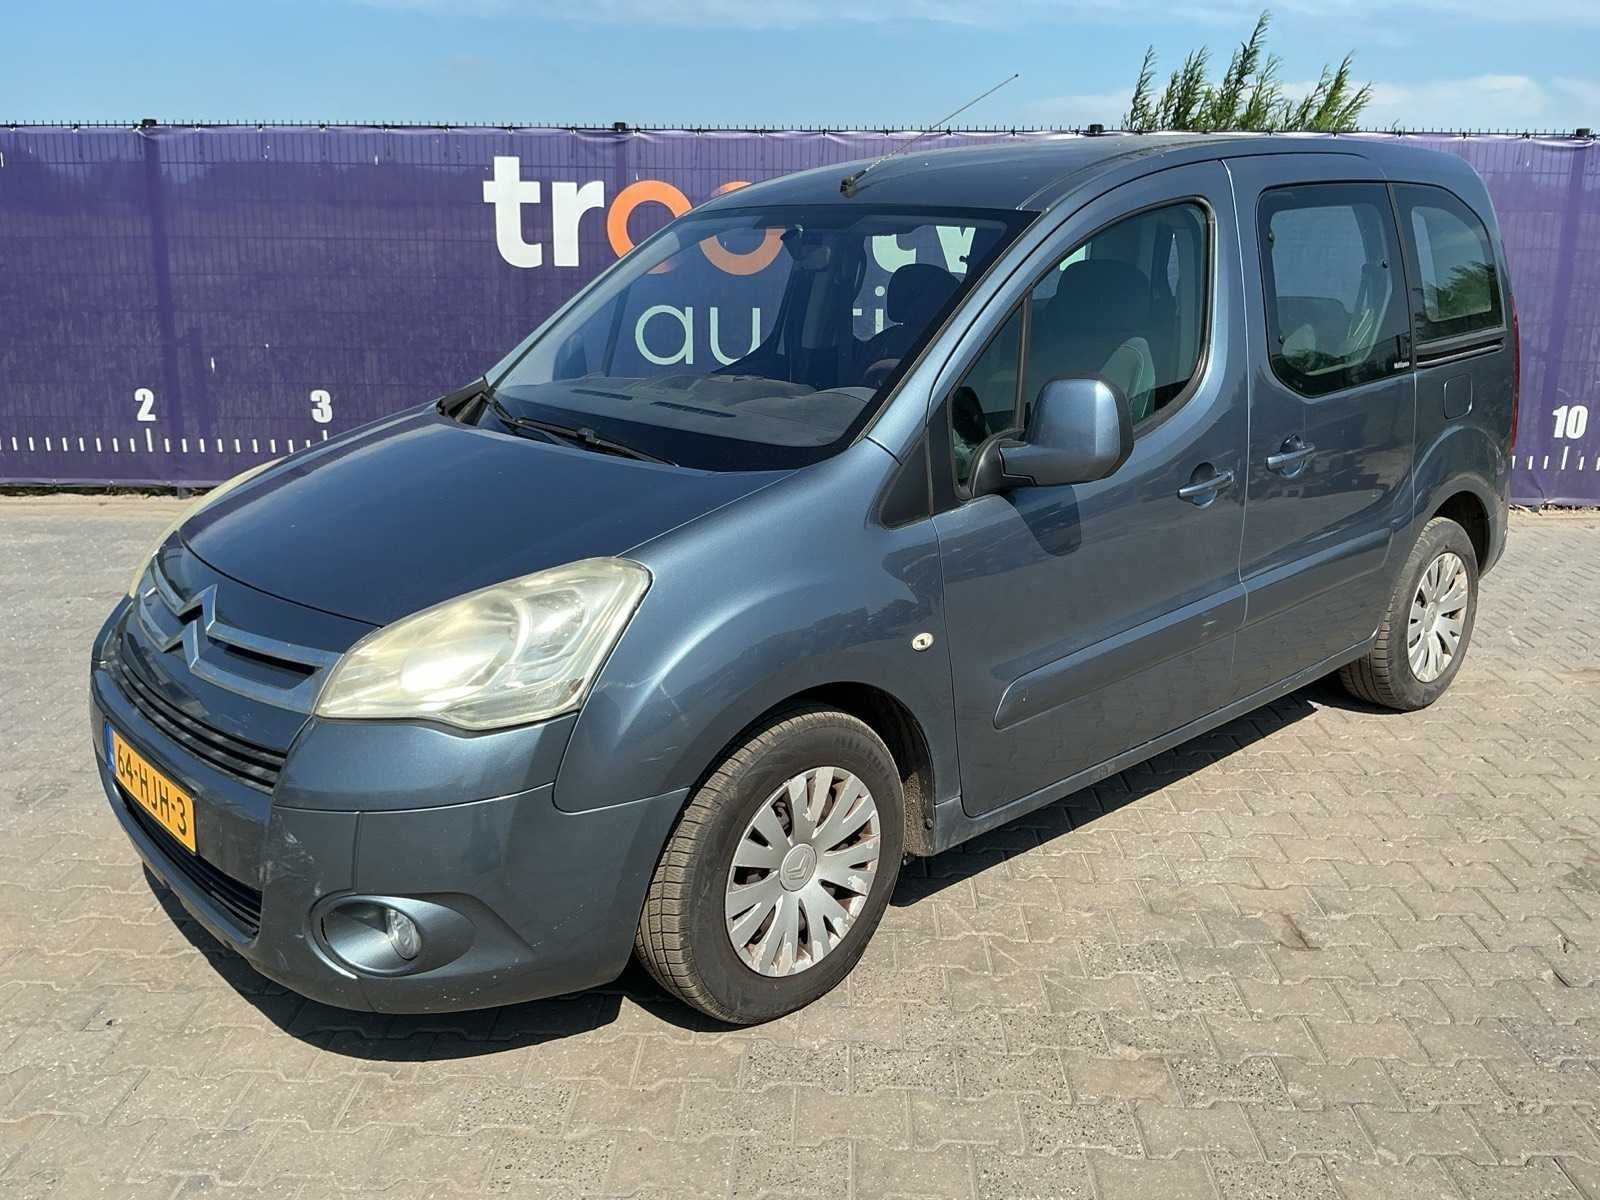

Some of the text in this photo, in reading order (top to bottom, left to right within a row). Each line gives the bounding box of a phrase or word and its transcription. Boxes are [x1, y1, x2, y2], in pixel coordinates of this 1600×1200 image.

[134, 388, 156, 421] 2
[310, 390, 333, 423] 3
[1552, 405, 1588, 439] 10
[117, 743, 188, 836] 64-HJH-3
